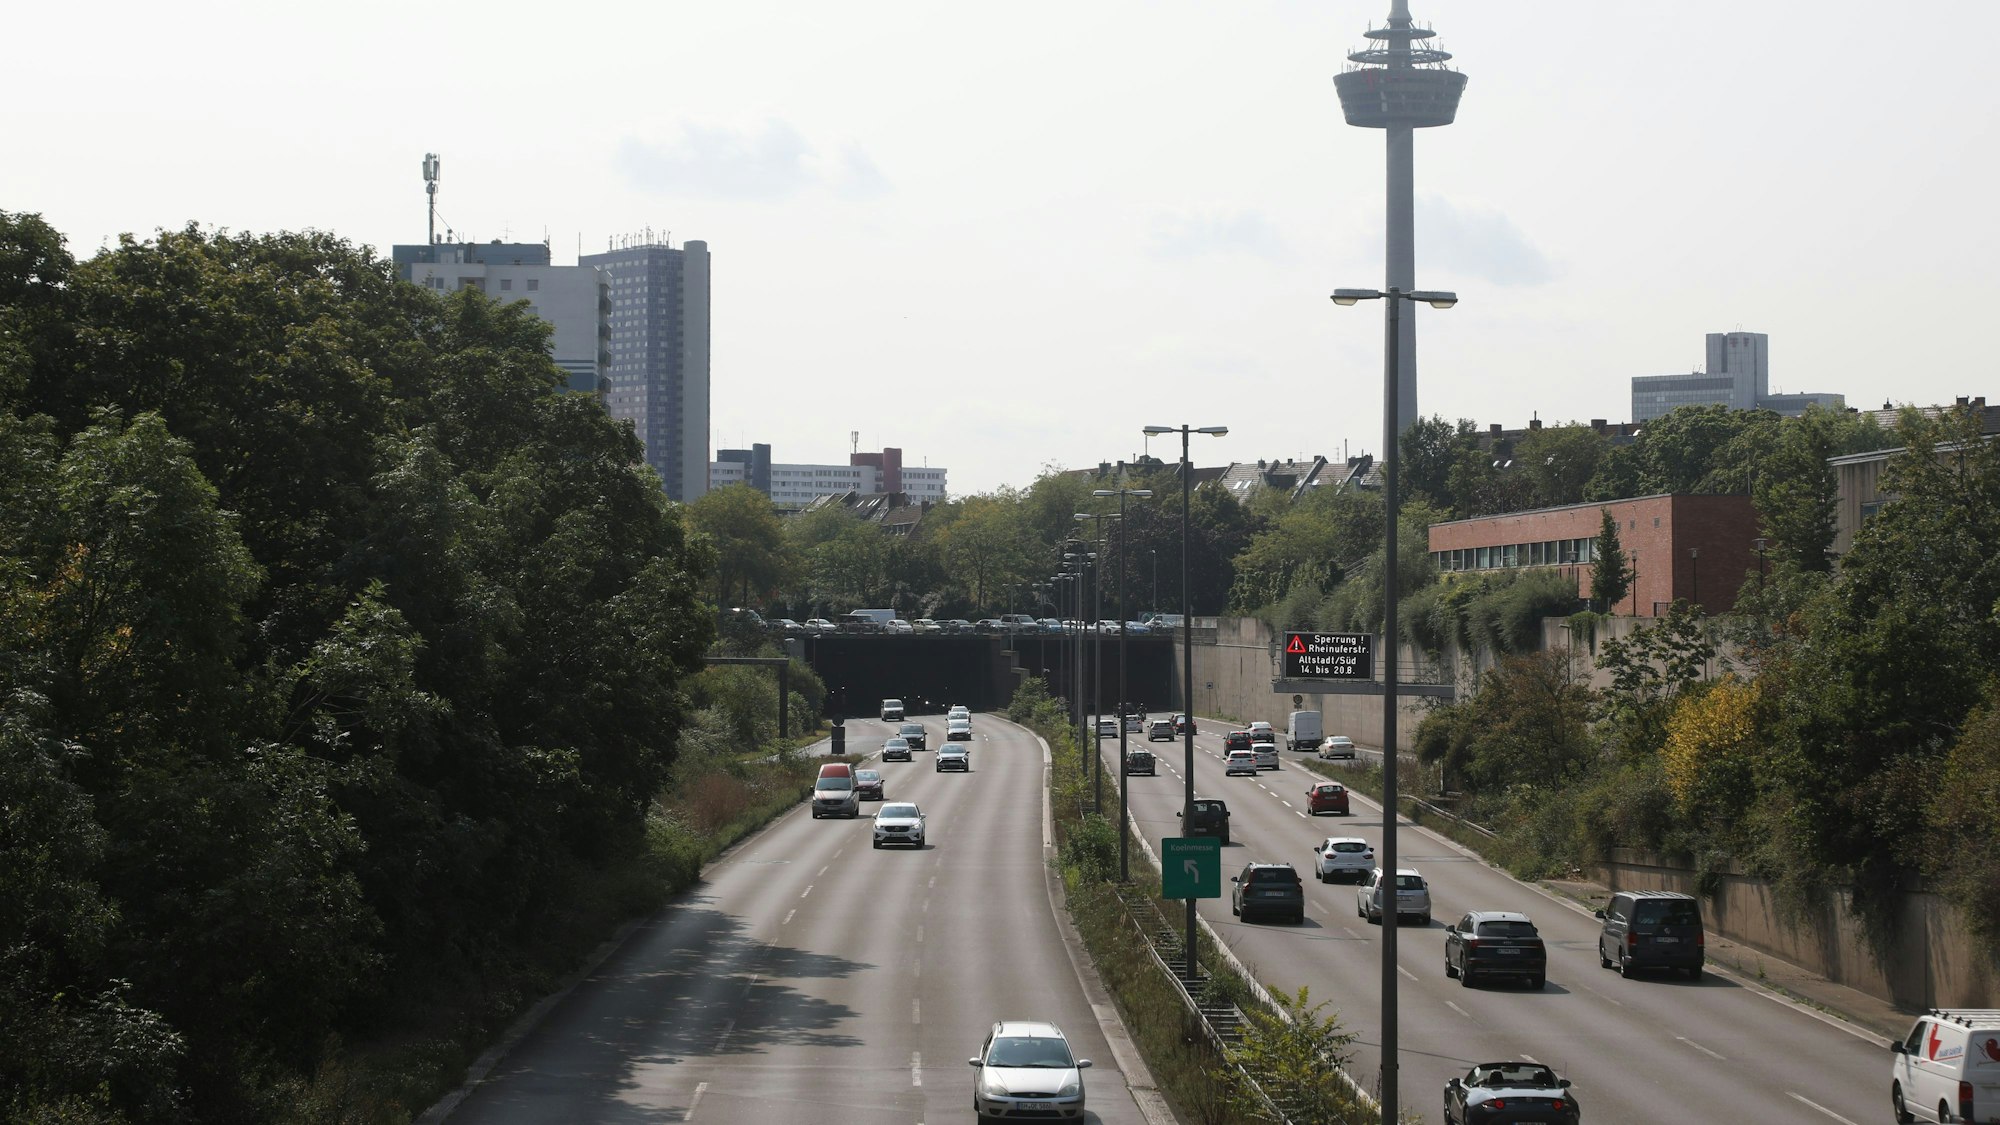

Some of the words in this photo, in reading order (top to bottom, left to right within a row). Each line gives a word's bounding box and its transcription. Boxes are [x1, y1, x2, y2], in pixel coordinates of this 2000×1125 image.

[1314, 635, 1356, 645] Sperrung
[1308, 644, 1369, 654] Rheinuferstr.
[1298, 656, 1357, 665] Altstadt/Süd
[1301, 665, 1312, 674] 14.
[1316, 666, 1329, 674] bis
[1334, 666, 1355, 675] 20.8.
[1170, 844, 1213, 852] Koelnmesse
